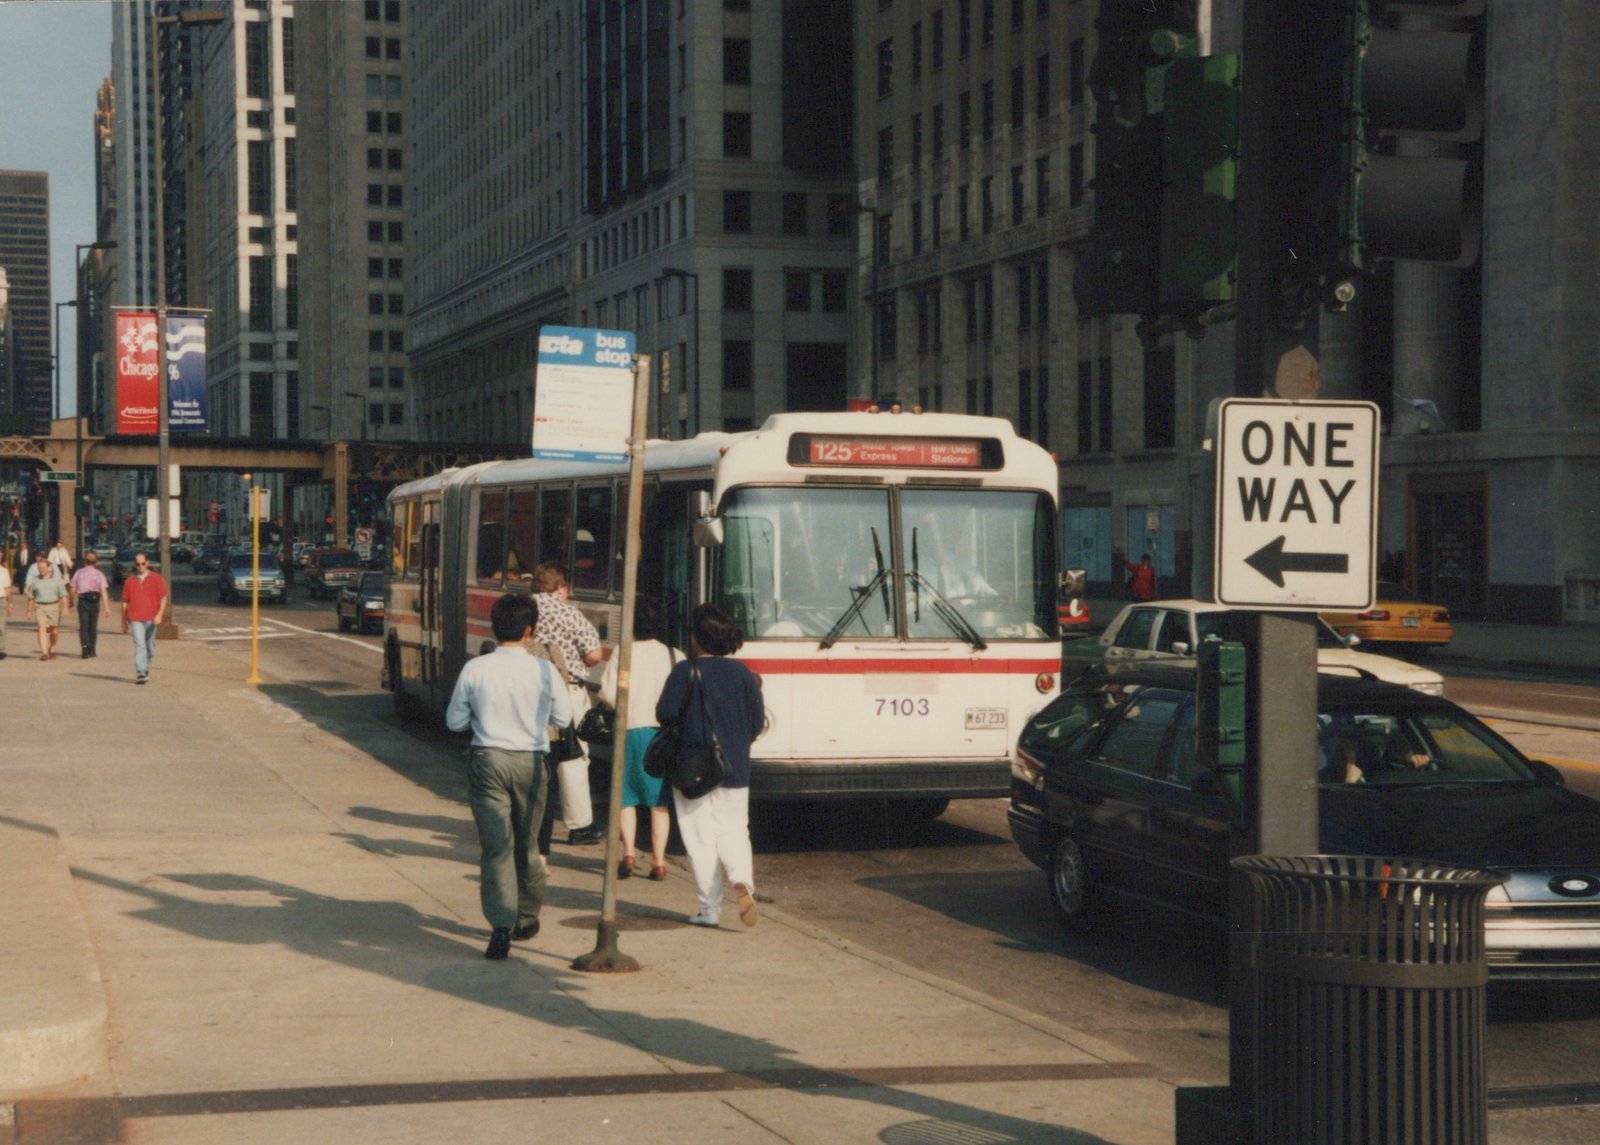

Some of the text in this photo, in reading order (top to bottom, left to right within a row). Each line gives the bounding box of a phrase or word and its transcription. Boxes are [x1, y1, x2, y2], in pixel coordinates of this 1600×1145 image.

[595, 332, 627, 349] bus
[595, 348, 631, 367] stop
[120, 356, 158, 380] Chicago
[815, 441, 852, 461] 125
[1242, 420, 1354, 467] ONE
[860, 451, 897, 461] Express
[931, 454, 969, 464] Stations
[1237, 477, 1357, 524] WAY
[875, 698, 930, 716] 7103
[975, 712, 986, 724] 67
[989, 712, 1005, 724] 233
